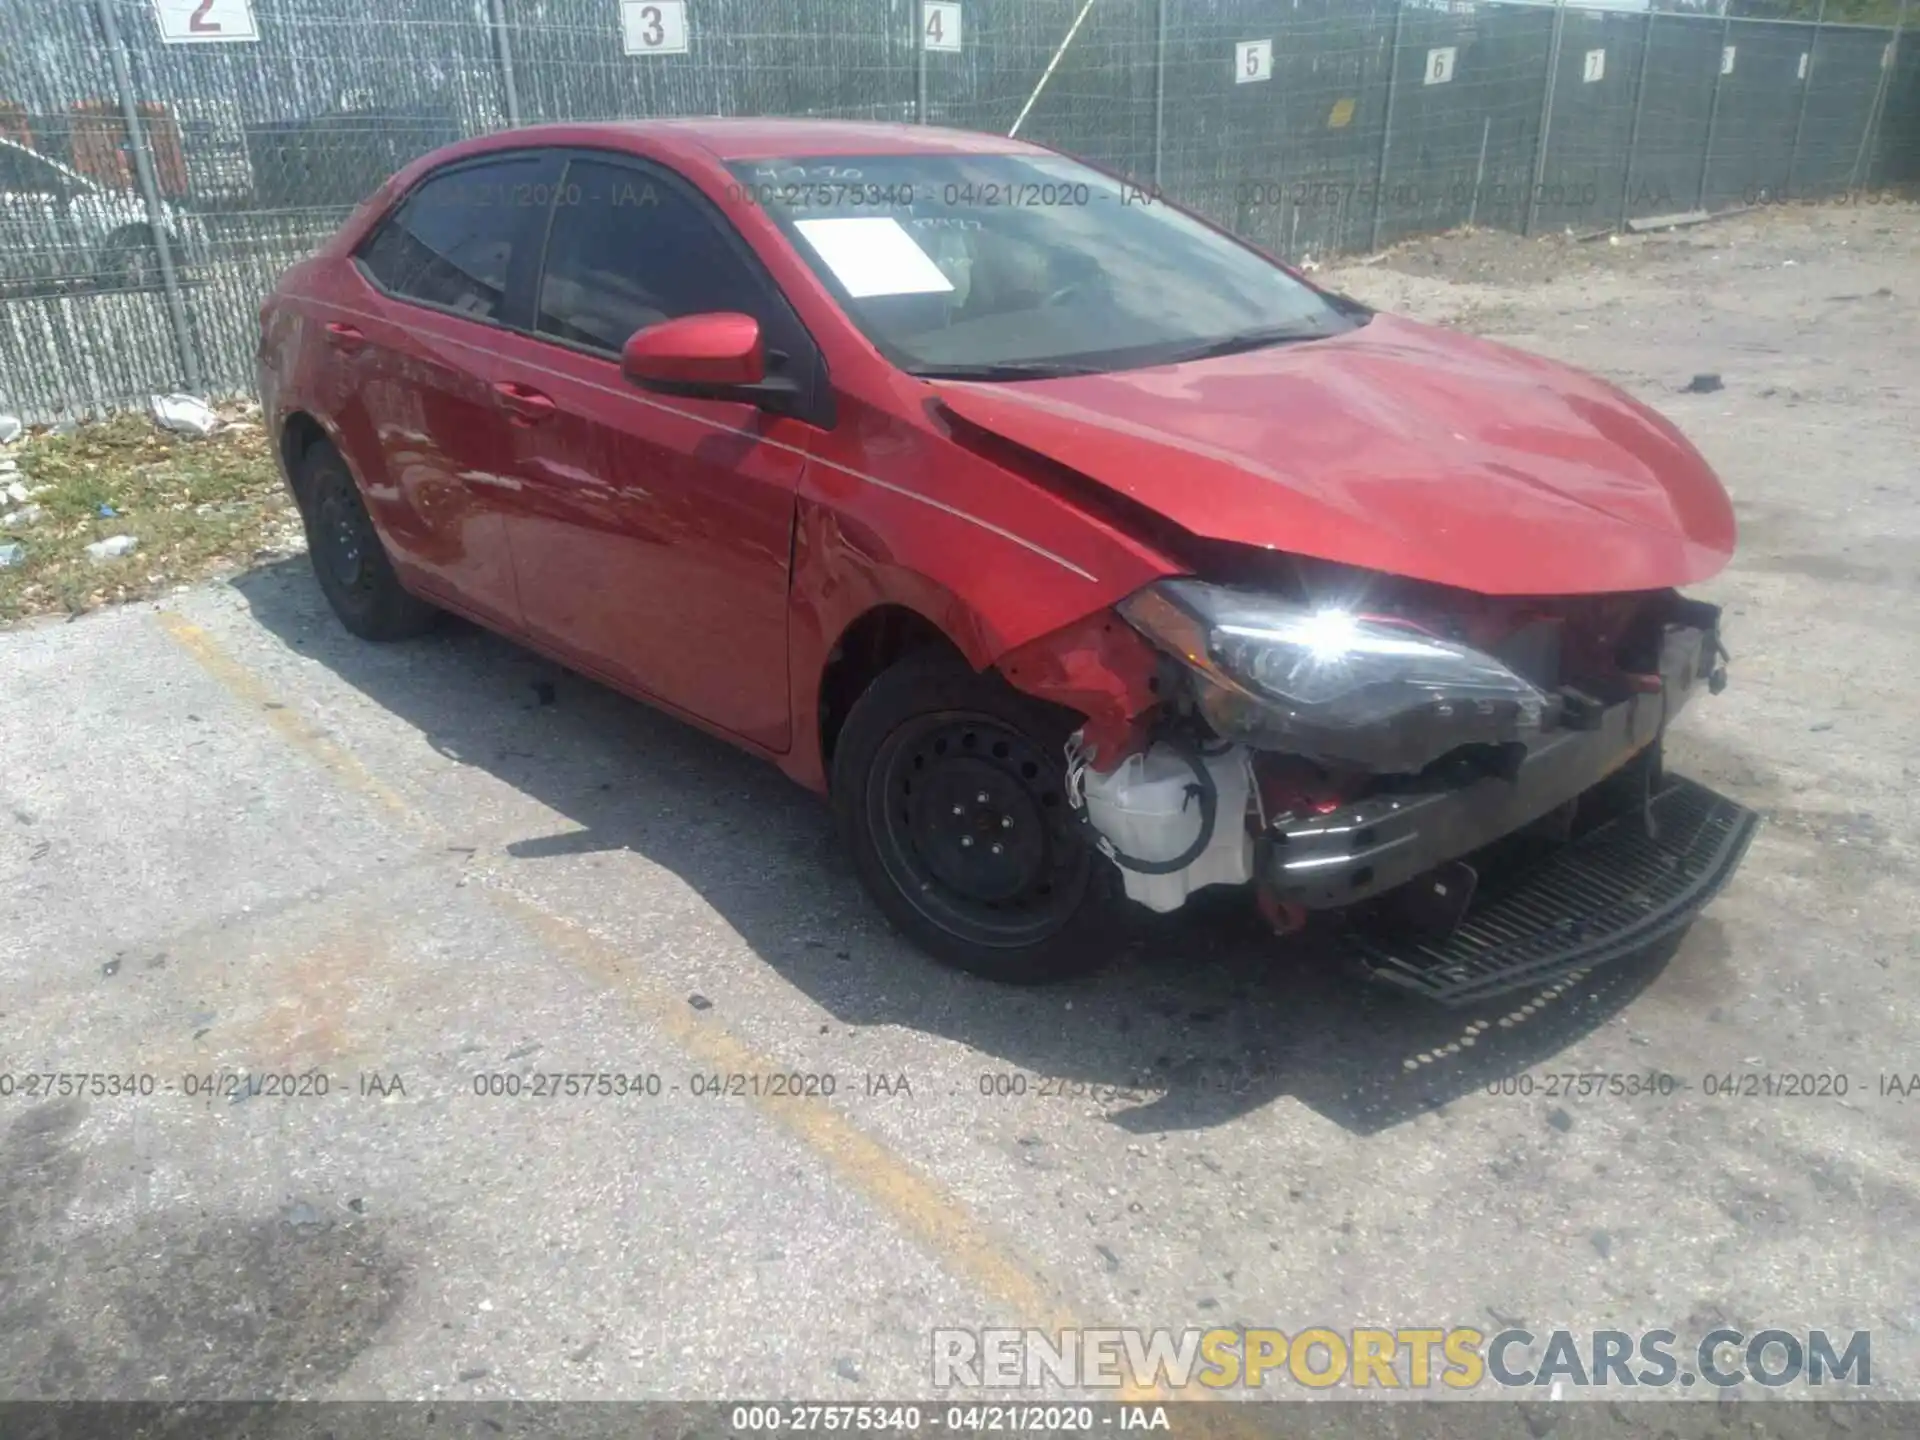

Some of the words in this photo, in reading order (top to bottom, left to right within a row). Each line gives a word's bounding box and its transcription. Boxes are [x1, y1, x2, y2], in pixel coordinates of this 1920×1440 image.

[190, 0, 221, 32] 2
[641, 6, 664, 46] 3
[926, 9, 943, 42] 4
[1246, 47, 1258, 76] 5
[1433, 54, 1446, 78] 6
[1590, 55, 1599, 76] 7
